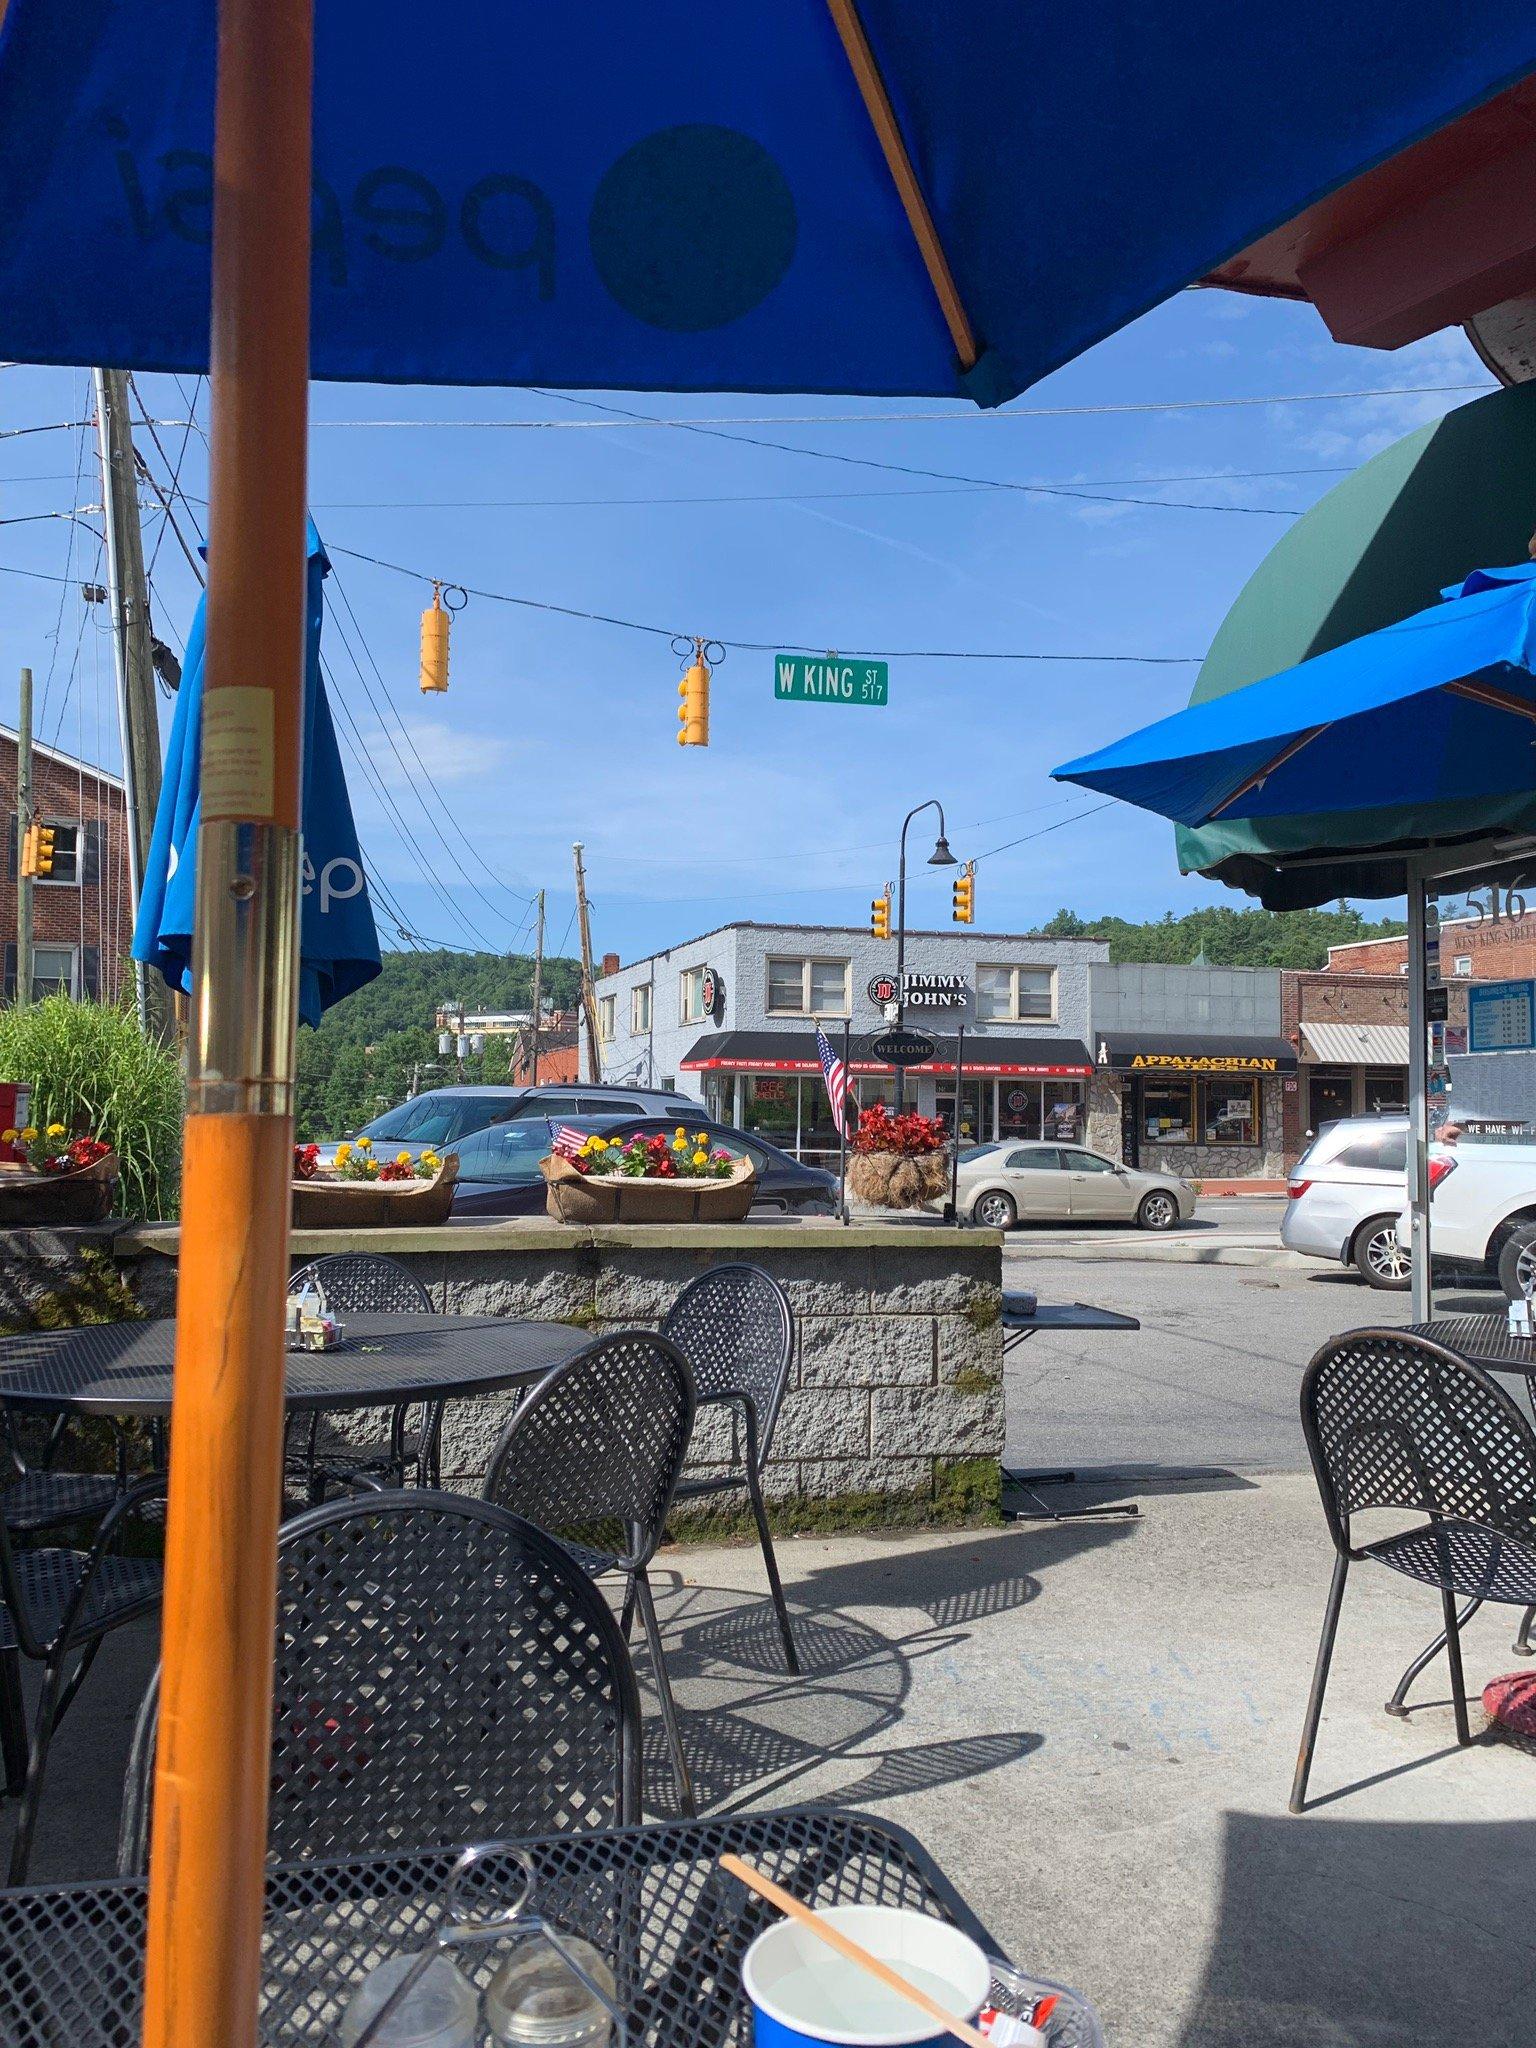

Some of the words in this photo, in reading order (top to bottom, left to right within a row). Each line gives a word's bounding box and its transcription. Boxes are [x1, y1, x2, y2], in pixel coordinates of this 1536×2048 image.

[779, 663, 795, 693] W
[804, 665, 853, 698] KING
[866, 670, 877, 685] ST
[862, 685, 883, 700] 517
[1466, 874, 1526, 929] 516
[1455, 934, 1477, 950] WEST
[1481, 930, 1501, 946] KING
[903, 974, 967, 989] JIMMY
[903, 992, 967, 1007] JOHN'S
[877, 1045, 932, 1054] WELCOME
[1131, 1055, 1277, 1071] APPALACHIAN
[752, 1081, 785, 1092] FREE
[1468, 1125, 1481, 1134] WE
[1485, 1125, 1506, 1134] HAVE
